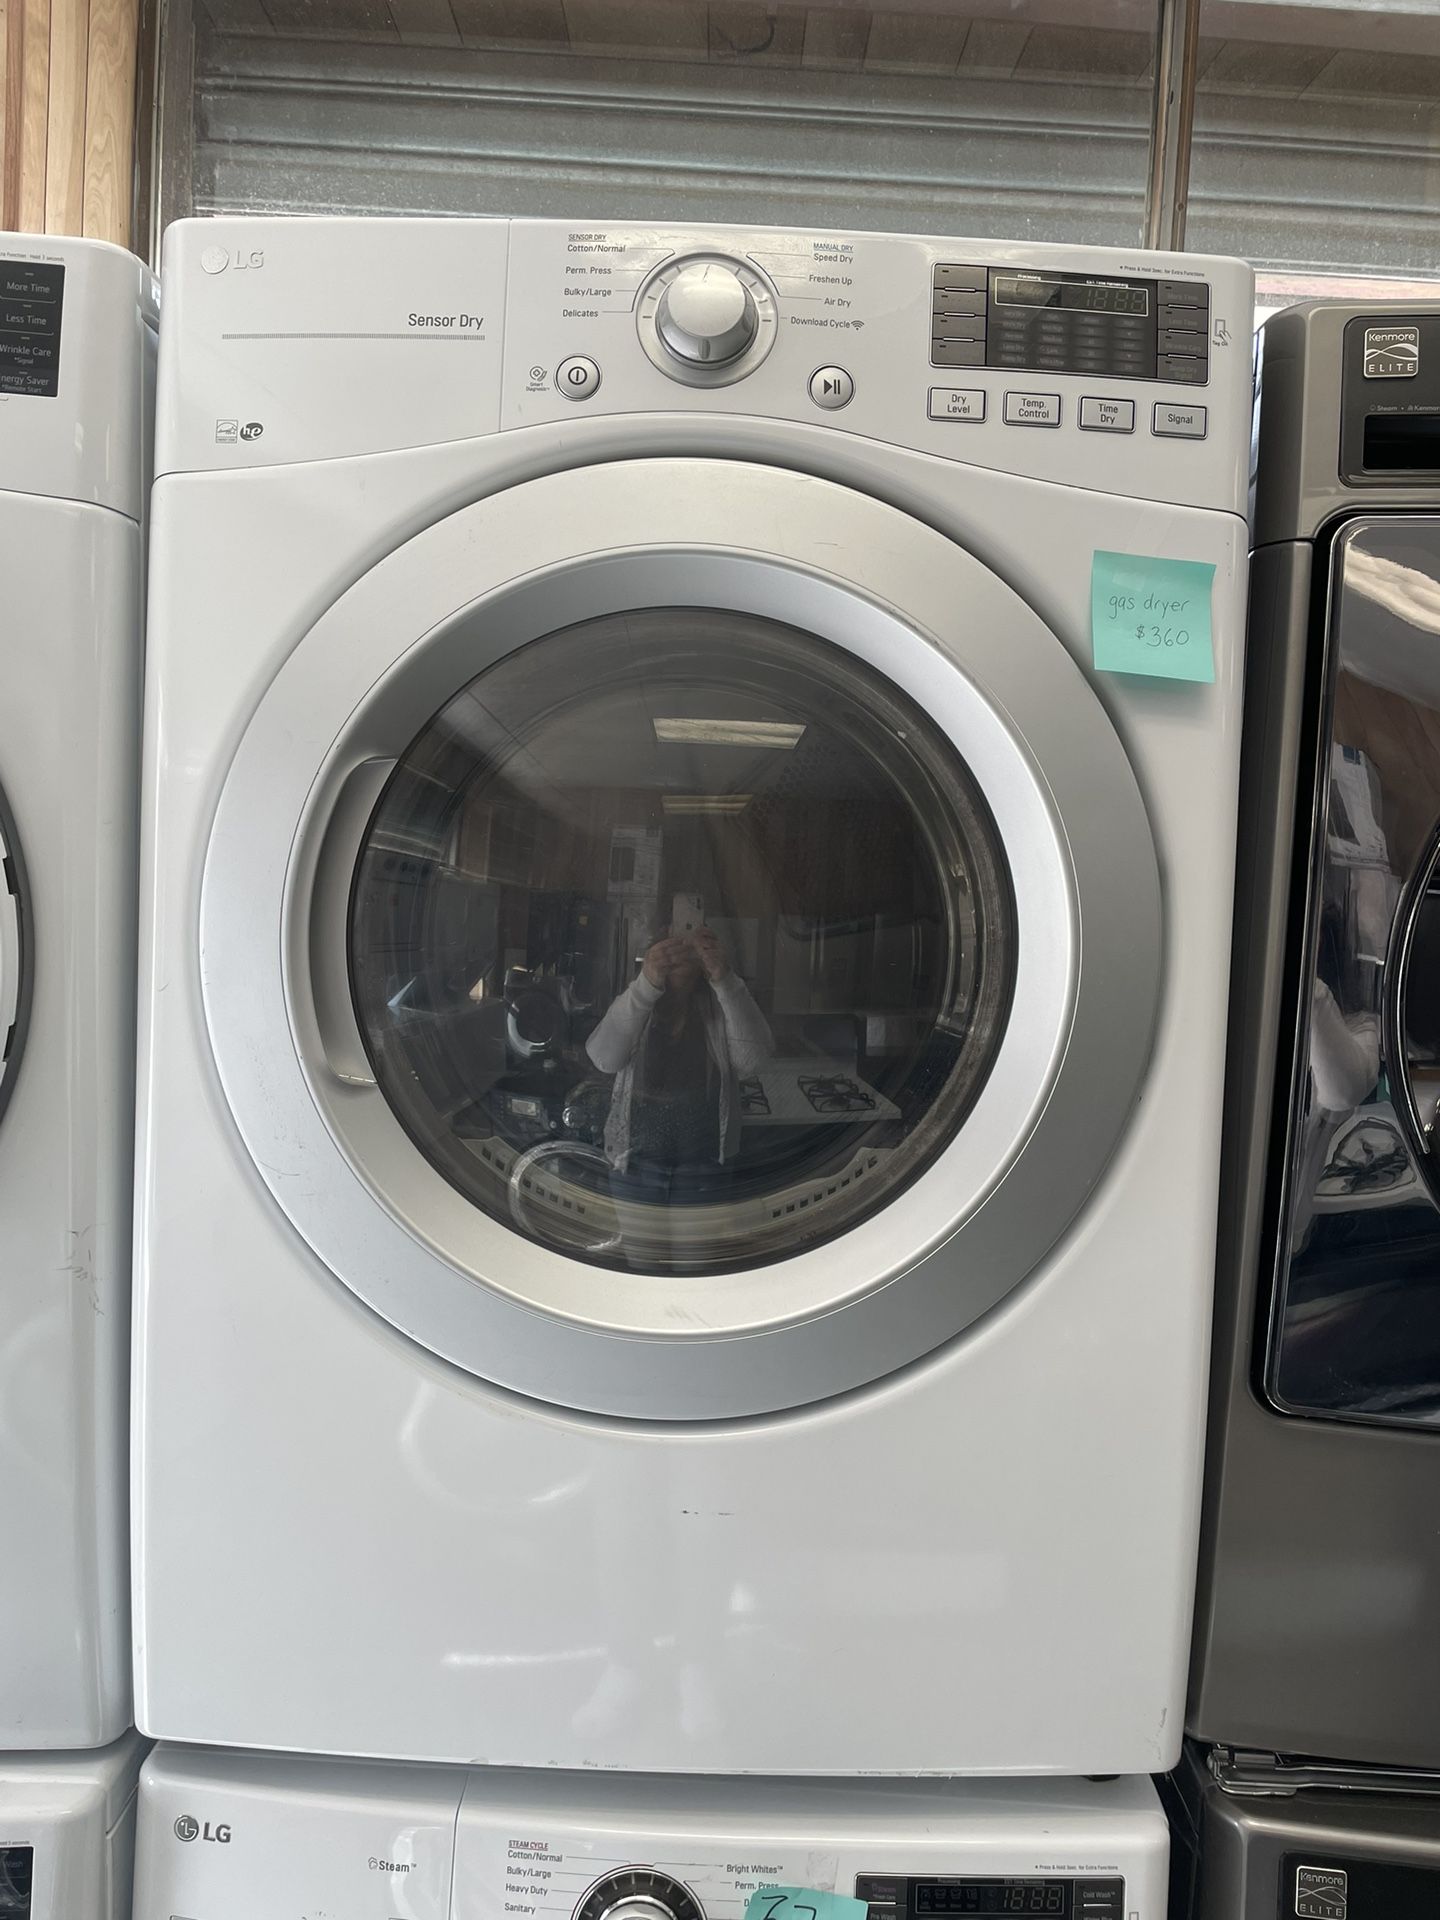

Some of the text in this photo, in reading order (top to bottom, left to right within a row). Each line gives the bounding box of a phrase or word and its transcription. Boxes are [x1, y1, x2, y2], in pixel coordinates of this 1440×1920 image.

[567, 244, 626, 252] Cotton/Normal
[813, 243, 840, 251] MANUAL
[233, 249, 264, 270] LG
[814, 253, 854, 264] Speed Dry
[566, 266, 612, 274] Perm. Press
[809, 275, 853, 286] Freshen Up
[7, 281, 50, 293] More Time
[564, 288, 612, 297] Bulky/Large
[824, 298, 851, 308] Air Dry
[563, 309, 599, 317] Delicates
[6, 313, 47, 326] Less Time
[408, 313, 484, 330] Sensor Dry
[791, 316, 851, 329] Download Cycle
[1368, 333, 1416, 342] Kenmore
[0, 344, 52, 357] Wrinkle Care
[1369, 363, 1415, 372] ELITE
[0, 375, 49, 386] nergy Saver
[951, 394, 967, 405] Dry
[1021, 398, 1047, 410] Temp.
[947, 404, 971, 414] Level
[1018, 408, 1050, 419] Control
[1099, 403, 1119, 414] Time
[1100, 414, 1116, 425] Dry
[1167, 413, 1193, 425] Signal
[1108, 592, 1190, 620] gas dryer
[1135, 625, 1190, 647] $360
[203, 1821, 232, 1843] LG
[509, 1840, 549, 1849] STEAM CYCLE
[507, 1850, 563, 1863] Cotton/Normal
[506, 1866, 552, 1879] Bulky/Large
[726, 1864, 750, 1874] Bright
[1300, 1872, 1344, 1885] Kenmore
[505, 1883, 548, 1896] Heavy Duty
[735, 1881, 757, 1890] Perm.
[504, 1903, 536, 1915] Sanitary
[1300, 1904, 1343, 1917] ELITE
